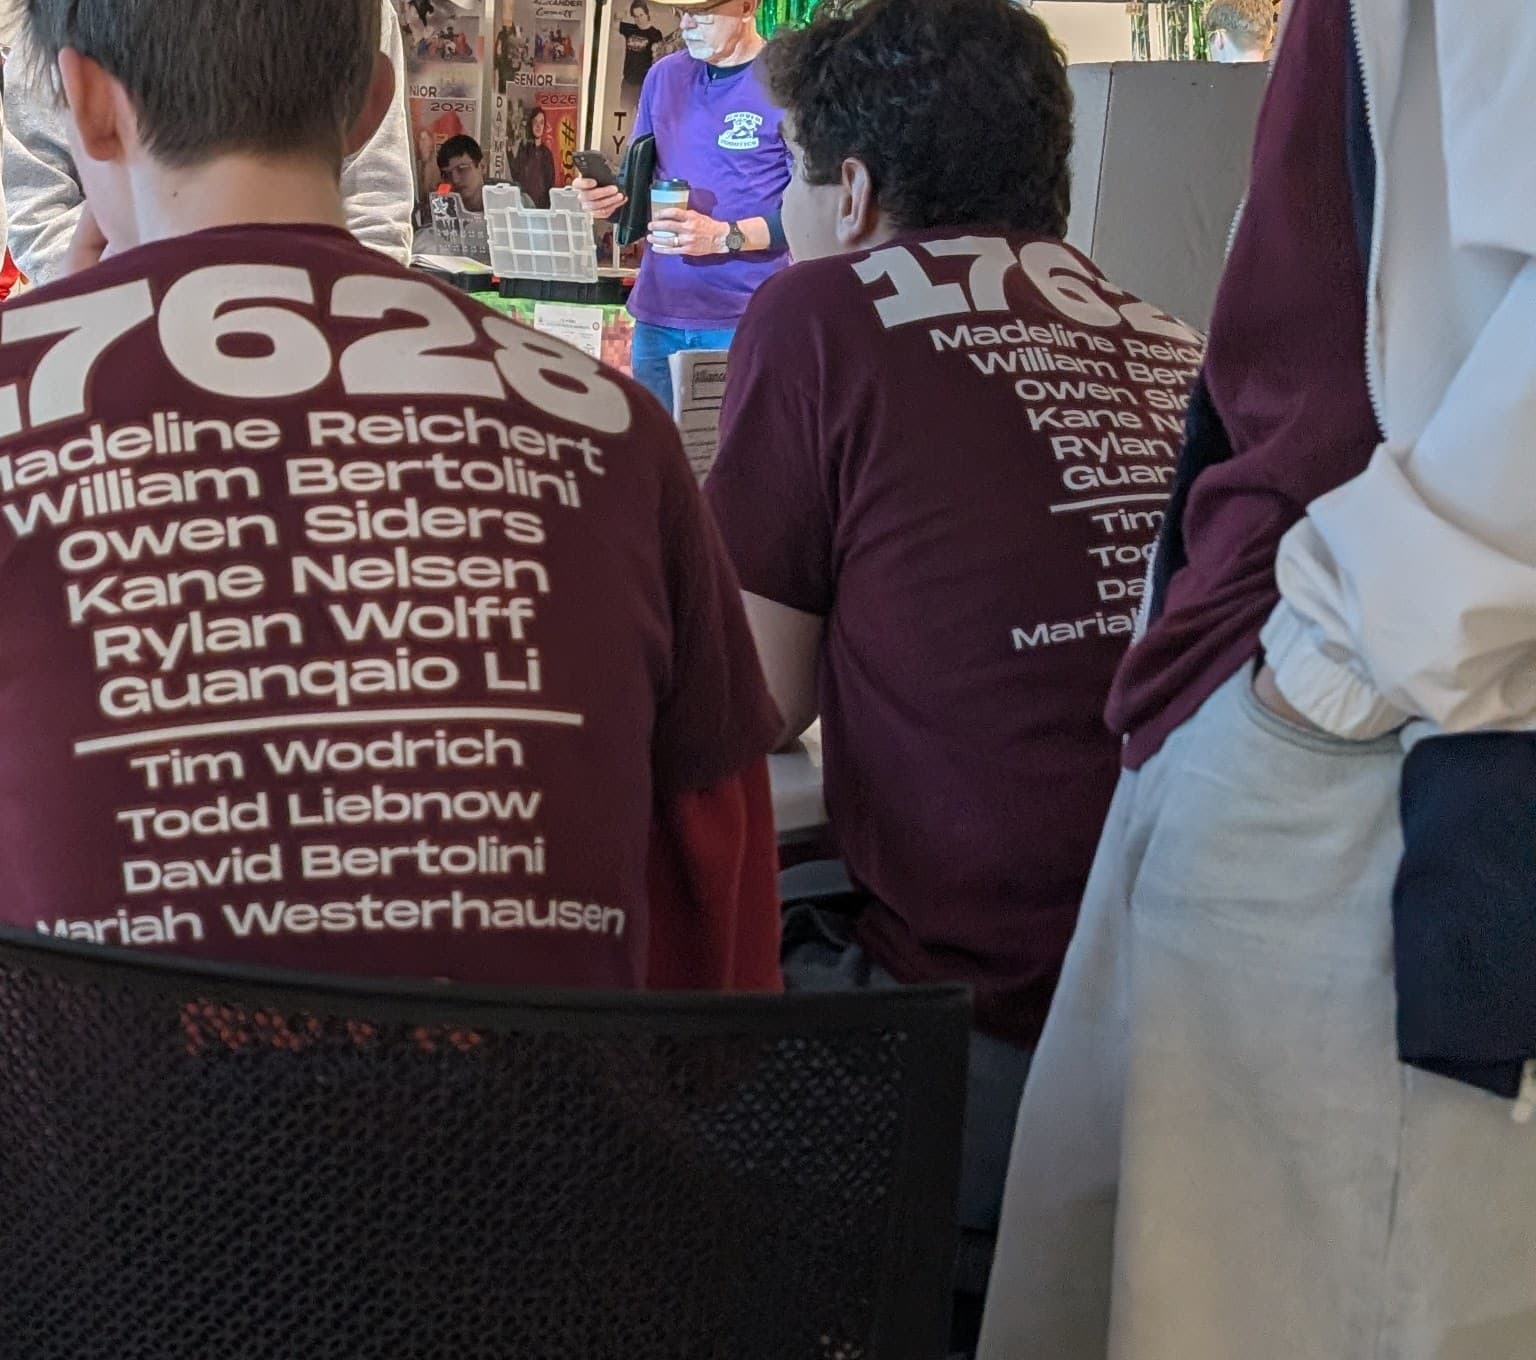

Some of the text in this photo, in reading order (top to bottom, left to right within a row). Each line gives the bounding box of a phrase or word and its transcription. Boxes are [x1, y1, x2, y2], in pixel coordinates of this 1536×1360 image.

[409, 84, 437, 98] NIOR
[514, 73, 554, 87] SENIOR
[541, 93, 577, 105] 2026
[430, 102, 475, 113] 2026
[851, 235, 1207, 344] 1762
[929, 318, 1116, 352] Madeline
[968, 346, 1119, 378] William
[1015, 378, 1139, 405] Owen
[307, 406, 606, 476] Reichert
[1026, 406, 1143, 432] Kane
[1050, 431, 1177, 464] Rylan
[2, 452, 582, 537] William Bertolini
[58, 497, 546, 572] Owen Siders
[66, 545, 551, 625] Kane Nelsen
[93, 595, 536, 672] Rylan Wolff
[99, 646, 542, 718] Guanqaio Li
[129, 728, 525, 790] Tim Wodrich
[117, 784, 543, 843] Todd Liebnow
[121, 835, 546, 895] David Bertolini
[222, 890, 626, 938] Westerhausen
